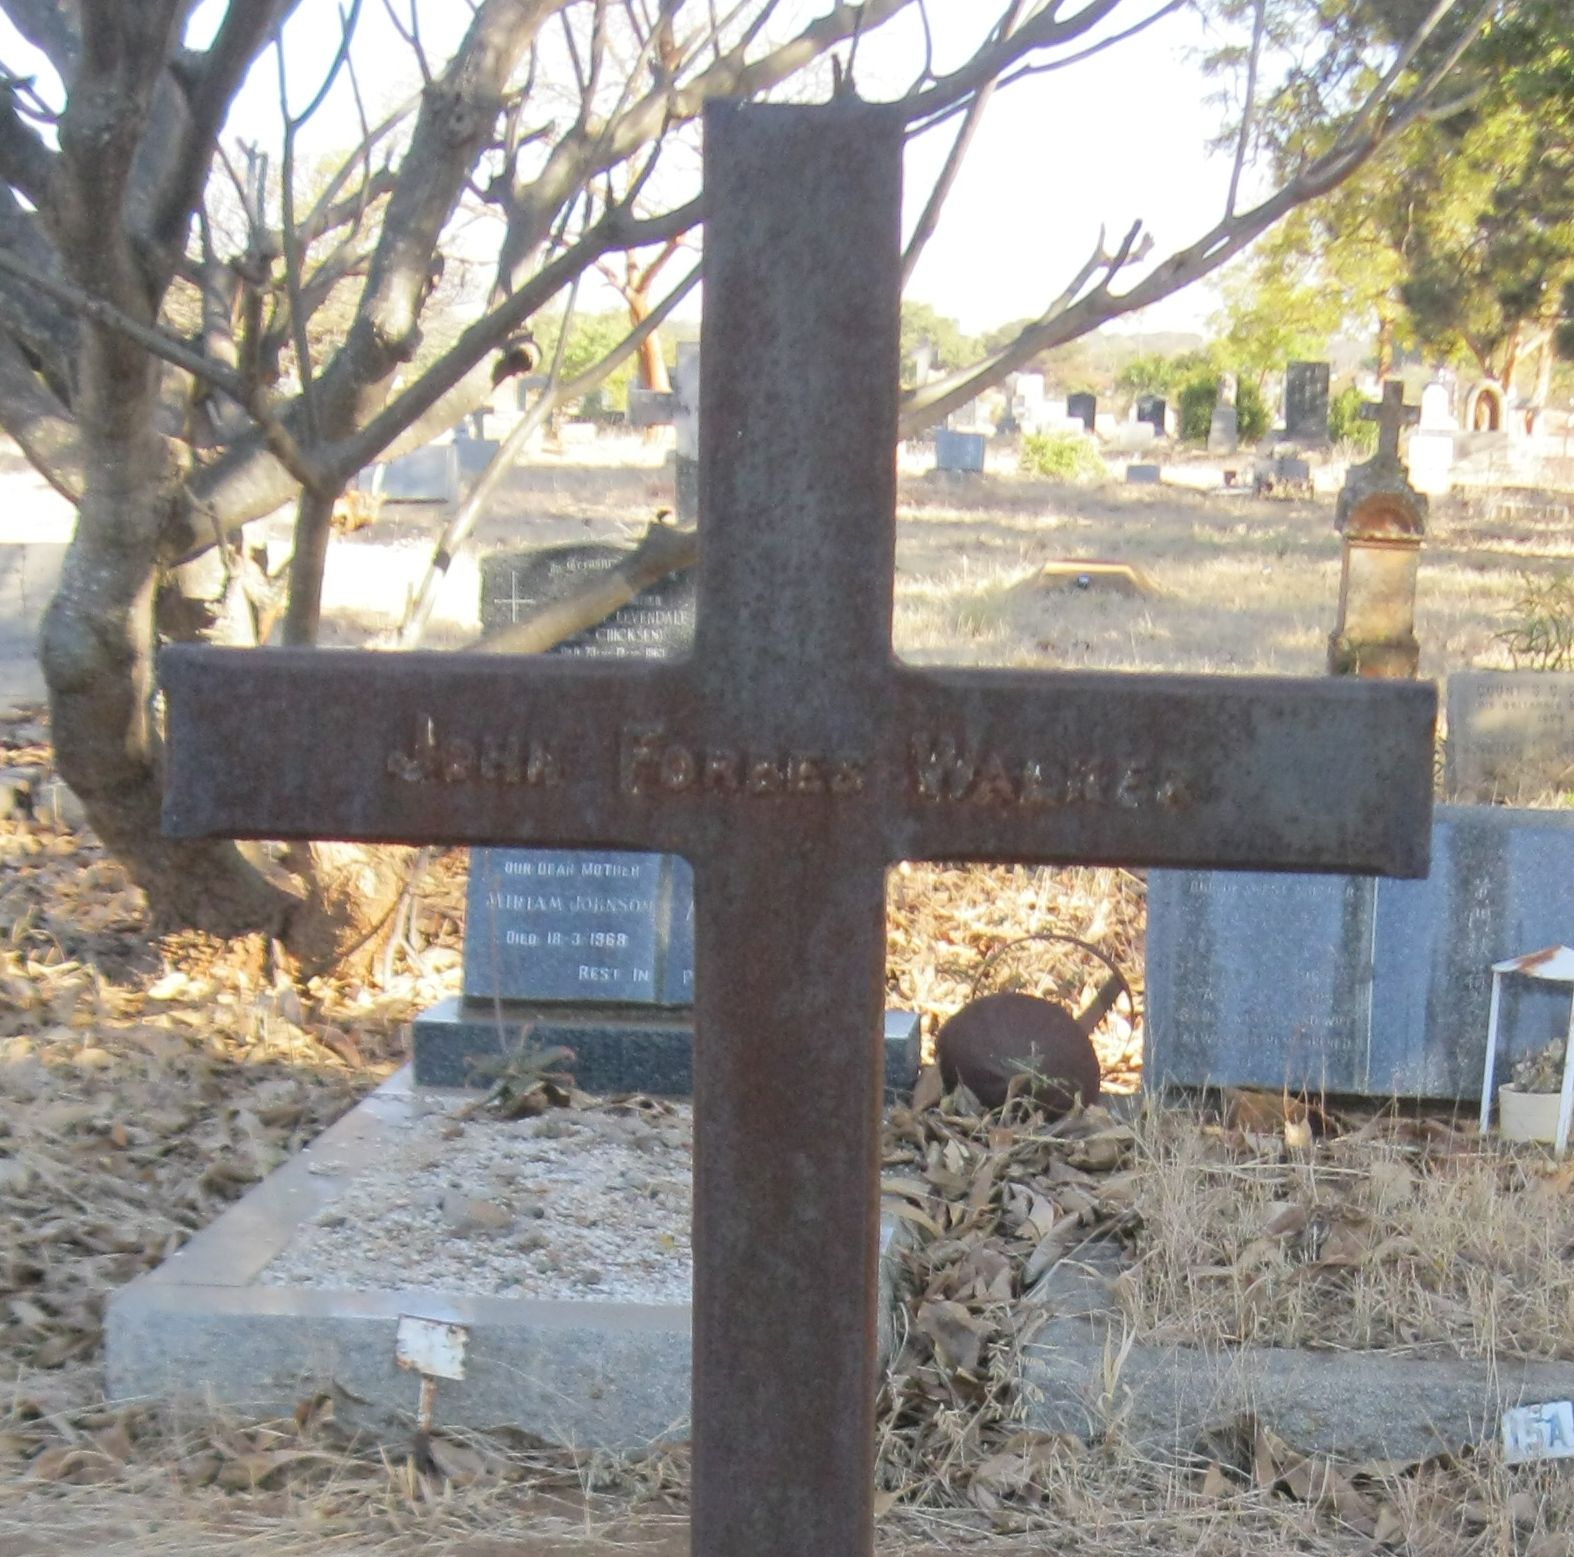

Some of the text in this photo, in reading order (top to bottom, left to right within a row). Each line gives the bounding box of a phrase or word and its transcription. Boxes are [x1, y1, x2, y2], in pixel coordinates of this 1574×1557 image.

[618, 719, 867, 796] FORBES
[909, 729, 1197, 811] WALKER
[504, 861, 640, 878] OUR DEAR MOTHER
[505, 930, 537, 945] DIED
[578, 965, 650, 982] REST IN
